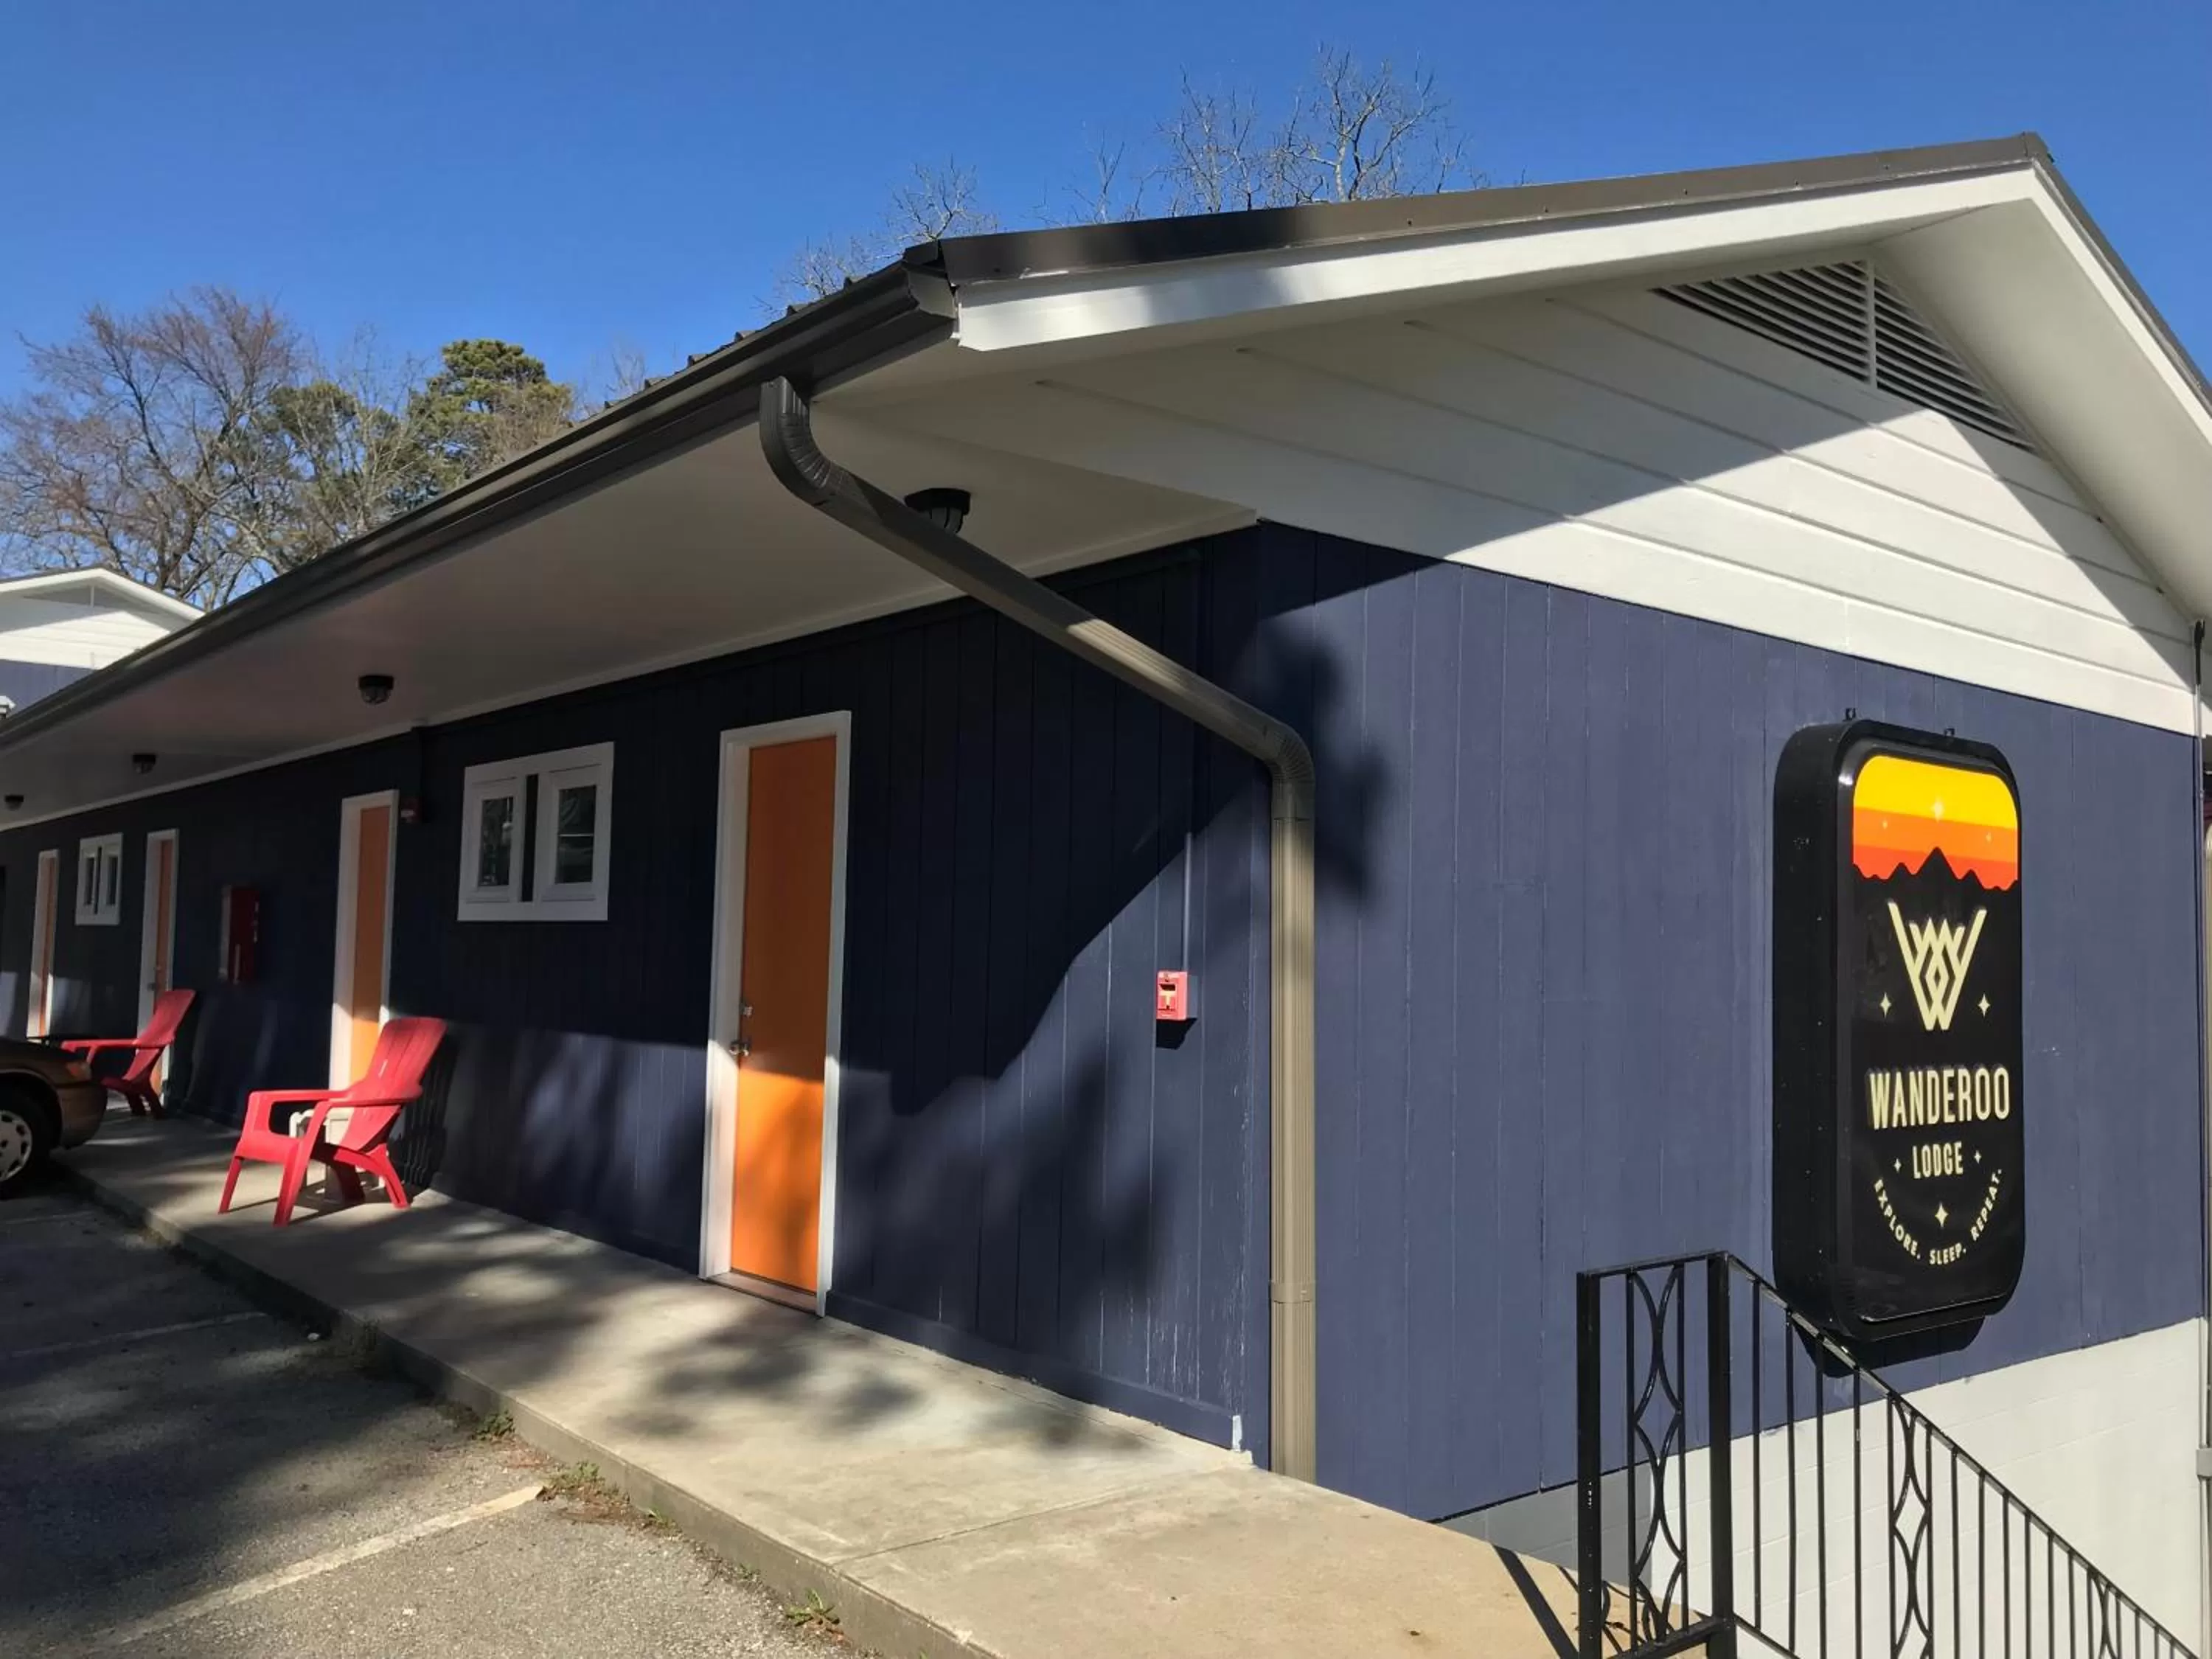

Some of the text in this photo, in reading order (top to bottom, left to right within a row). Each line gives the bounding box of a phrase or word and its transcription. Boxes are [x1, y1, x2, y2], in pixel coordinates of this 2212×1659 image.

[1869, 1067, 2011, 1130] WANDEROO
[1912, 1141, 1964, 1179] LODGE
[1874, 1179, 1921, 1259] EXPLORE.
[1929, 1242, 1967, 1265] SLEEP.
